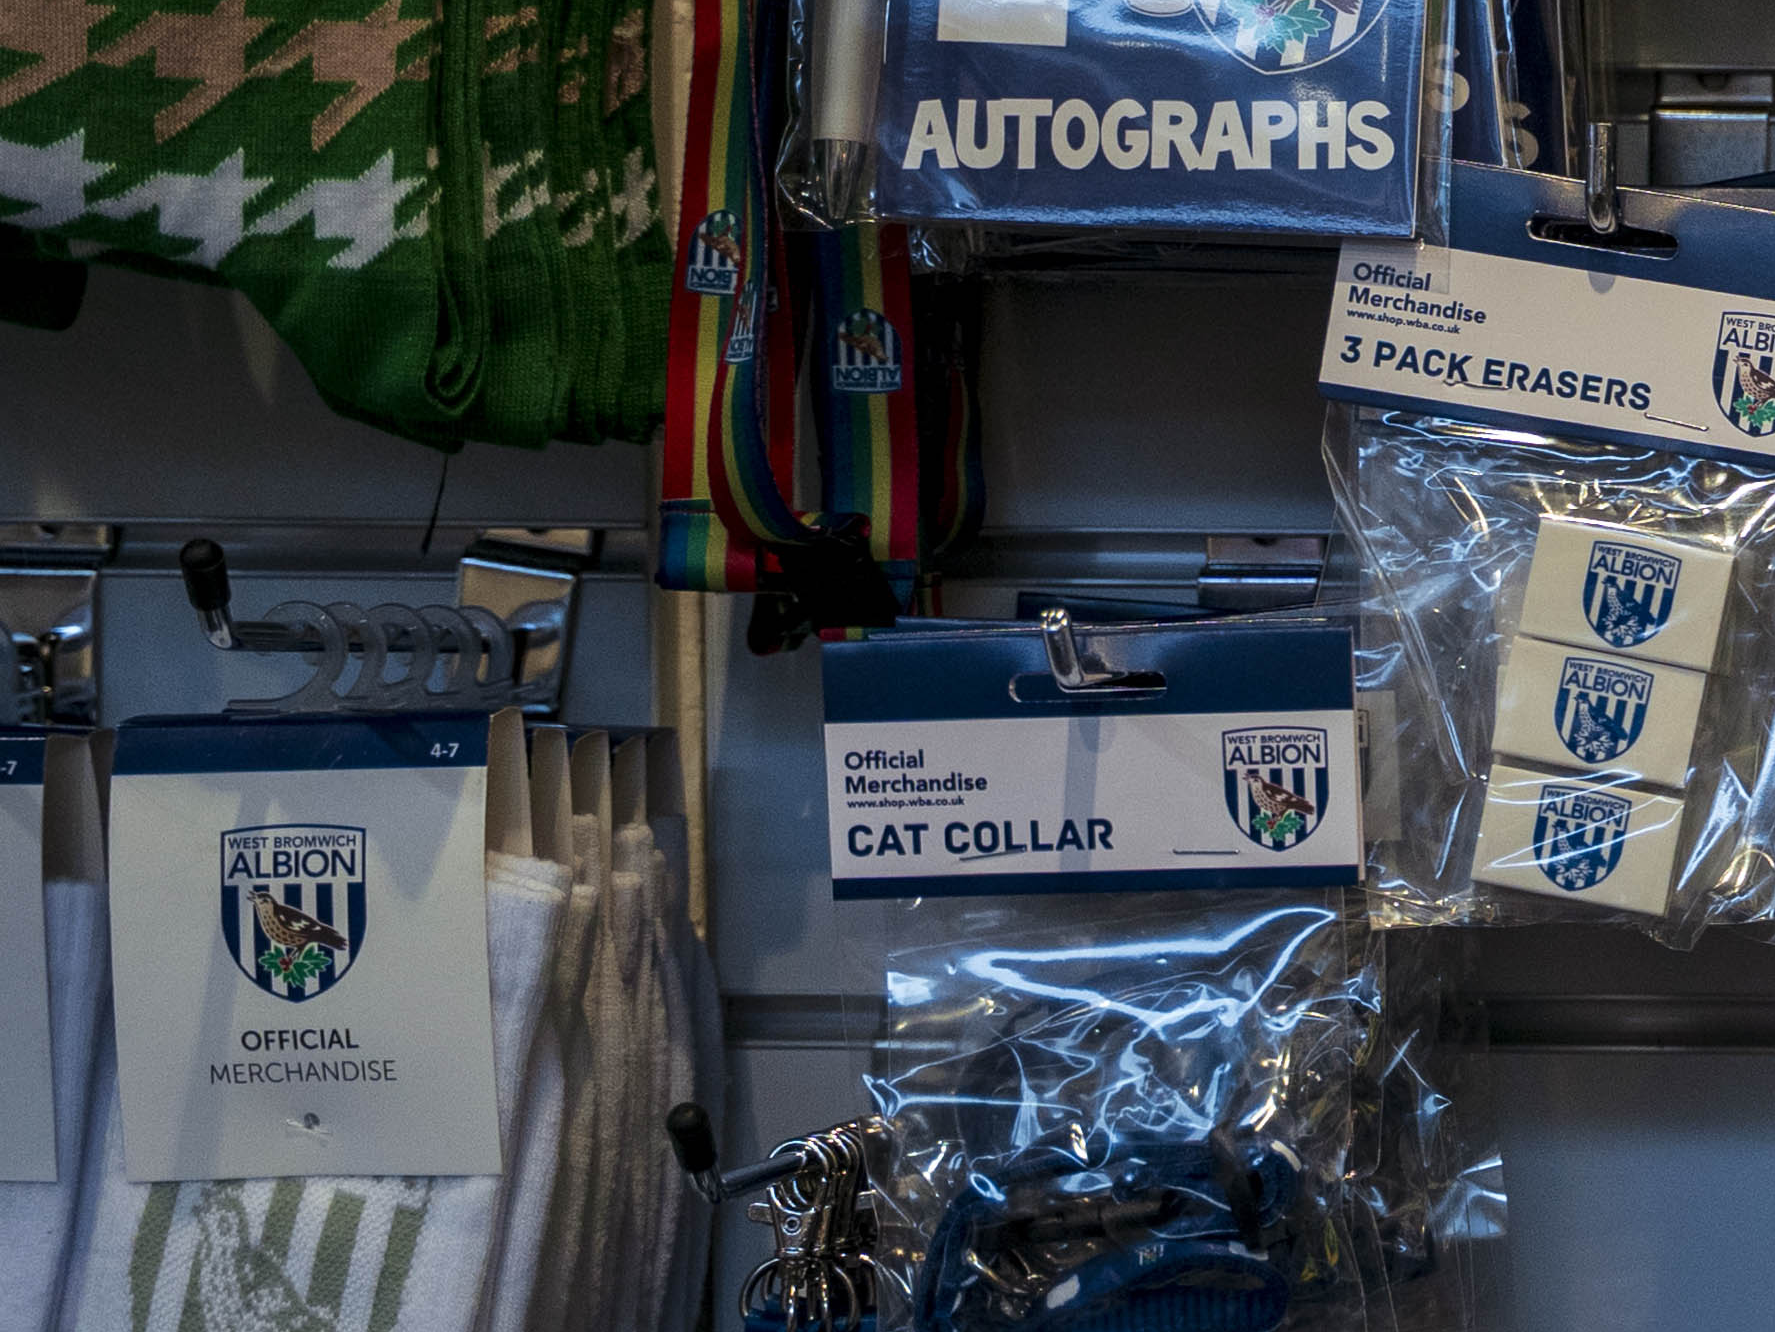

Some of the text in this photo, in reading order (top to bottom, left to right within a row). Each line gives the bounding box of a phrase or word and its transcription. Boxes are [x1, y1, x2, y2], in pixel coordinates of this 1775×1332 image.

[902, 98, 1396, 171] AUTOGRAPHS
[1353, 262, 1431, 291] Official
[1348, 286, 1487, 324] Merchandise
[1347, 307, 1461, 335] www.shop.wba.co.uk
[1726, 317, 1755, 329] WEST
[1340, 336, 1651, 409] 3 PACK ERASERS
[1593, 555, 1674, 584] ALBION
[1597, 545, 1677, 568] WEST BROMWICH
[1566, 671, 1647, 700] ALBION
[430, 742, 459, 759] 4-7
[844, 750, 924, 771] Official
[1229, 744, 1322, 766] ALBION
[845, 772, 987, 795] Merchandise
[847, 796, 965, 808] www.shop.wba.co.uk
[1543, 799, 1625, 827] ALBION
[227, 834, 356, 849] WEST BROMWICH
[847, 818, 1113, 857] CAT COLLAR
[227, 849, 356, 879] ALBION
[241, 1028, 359, 1052] OFFICIAL
[210, 1059, 397, 1085] MERCHANDISE
